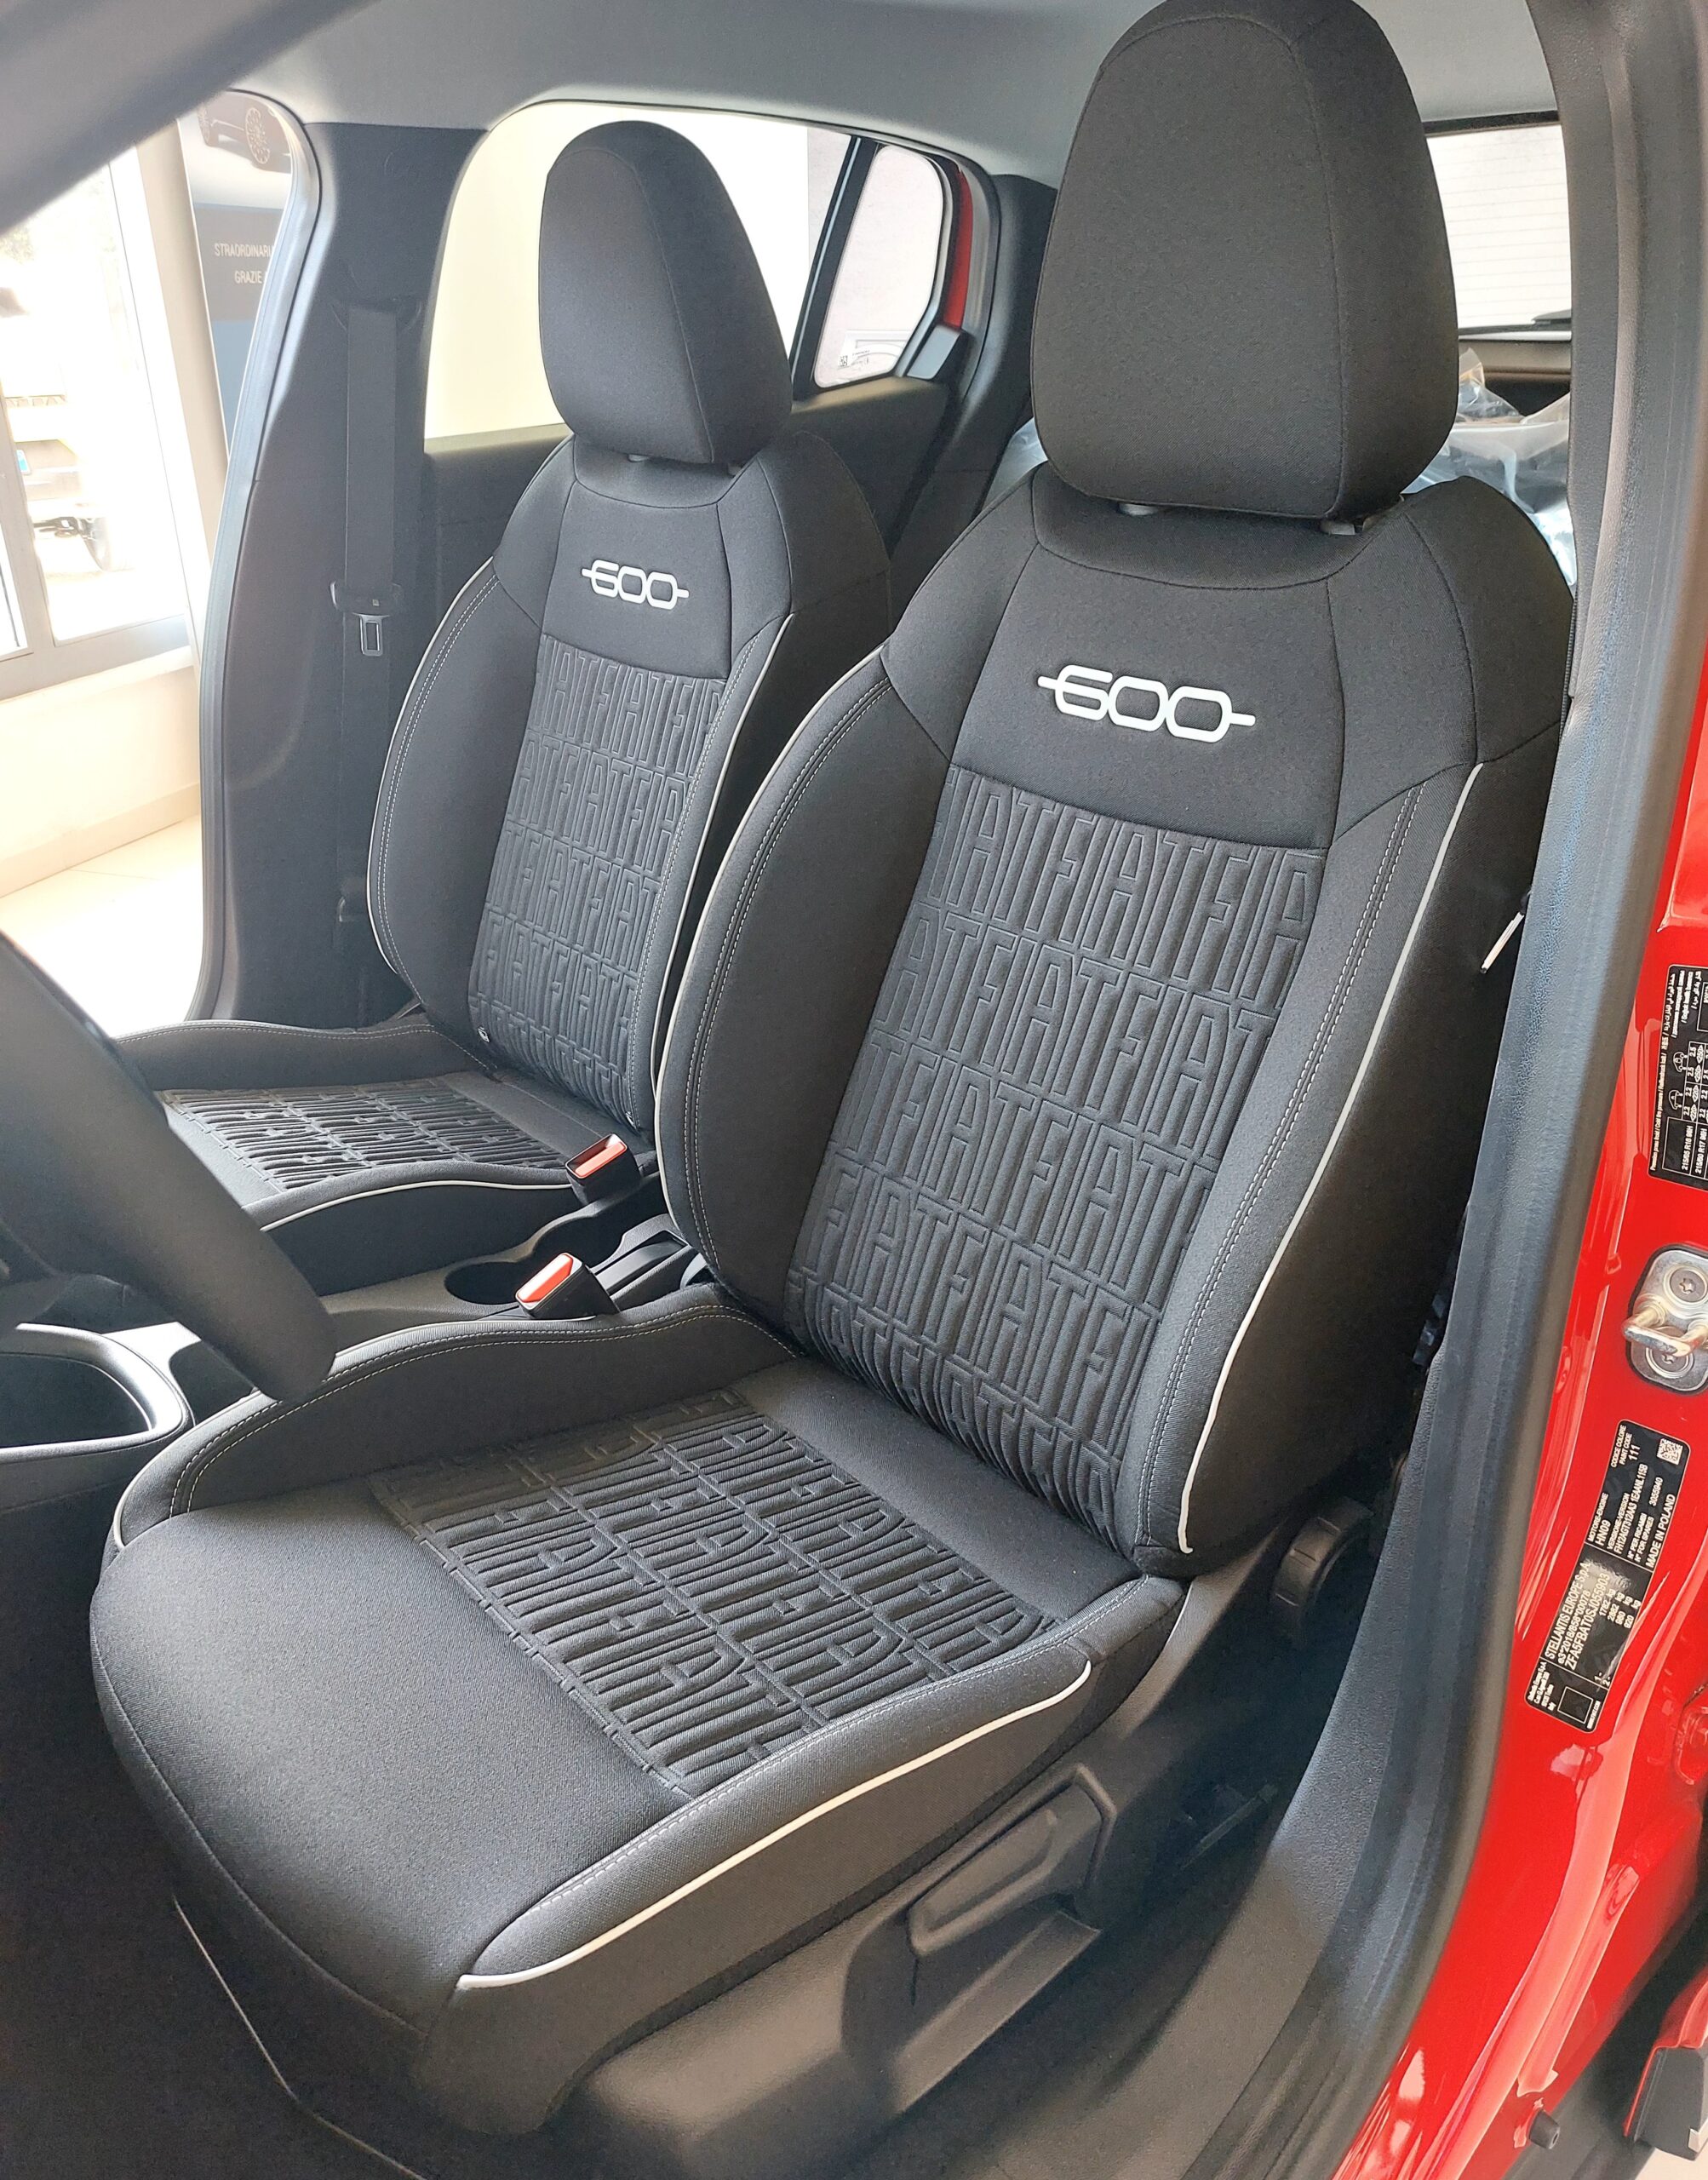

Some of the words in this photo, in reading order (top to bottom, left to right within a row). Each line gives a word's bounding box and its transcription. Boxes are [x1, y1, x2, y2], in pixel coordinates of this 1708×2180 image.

[235, 270, 262, 283] GRAZIE
[582, 559, 689, 610] 600
[1038, 664, 1256, 743] 600
[1609, 1447, 1621, 1467] CODICE
[1615, 1425, 1626, 1447] COLORE
[1623, 1432, 1631, 1449] CODE
[1619, 1448, 1628, 1465] PAINT
[1628, 1443, 1640, 1461] 111
[1657, 1493, 1676, 1531] POLAND
[1595, 1518, 1611, 1546] HN09
[1654, 1530, 1665, 1540] IN
[1630, 1537, 1639, 1551] PER
[1636, 1540, 1647, 1554] FOR
[1646, 1540, 1661, 1568] MADE
[1613, 1592, 1625, 1602] kg
[1622, 1595, 1633, 1605] kg
[1630, 1599, 1642, 1609] kg
[1544, 1612, 1570, 1660] STELLANTIS
[1562, 1580, 1583, 1615] EUROPE
